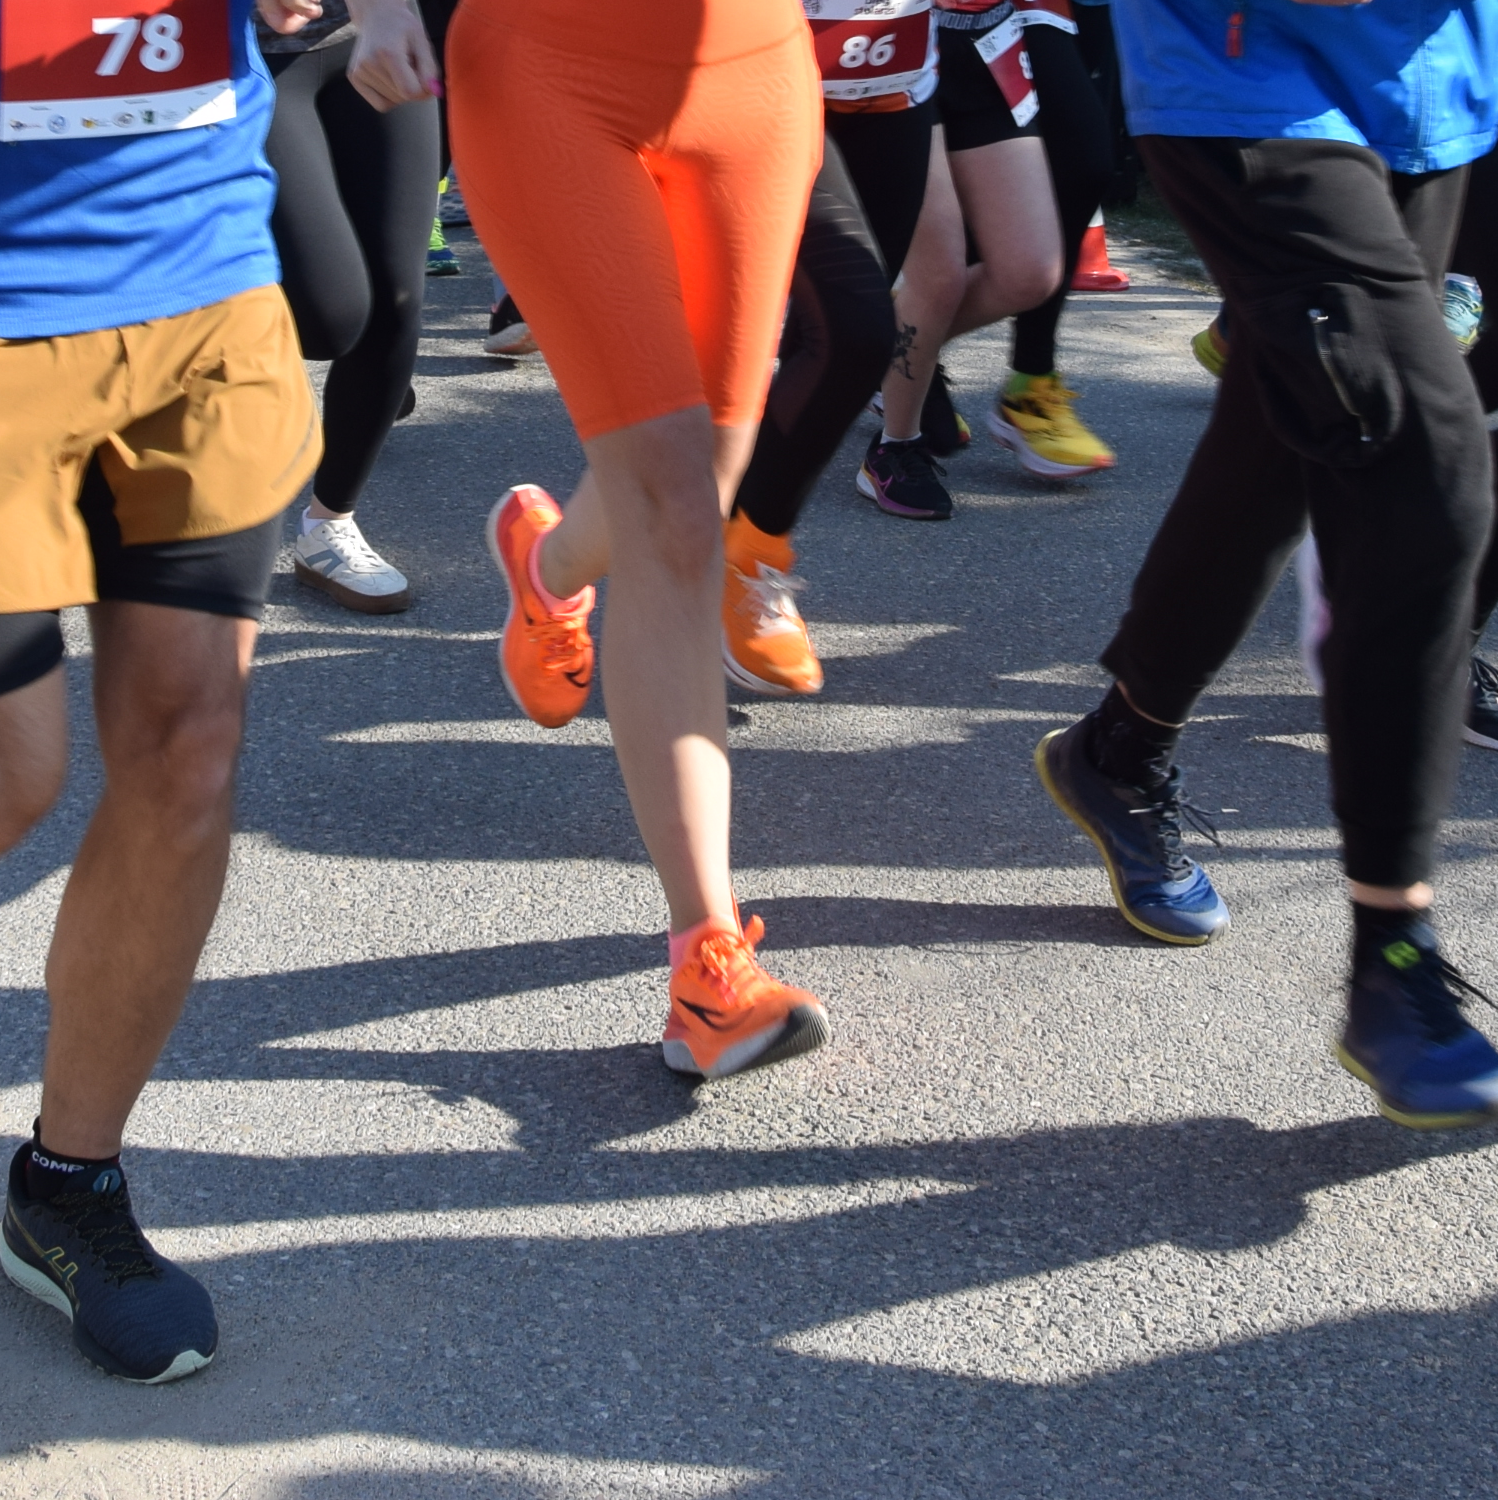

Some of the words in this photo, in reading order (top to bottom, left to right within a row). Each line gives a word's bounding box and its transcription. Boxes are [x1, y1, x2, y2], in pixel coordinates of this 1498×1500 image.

[91, 12, 185, 77] 78
[838, 33, 897, 68] 86
[32, 1150, 85, 1174] COMP
